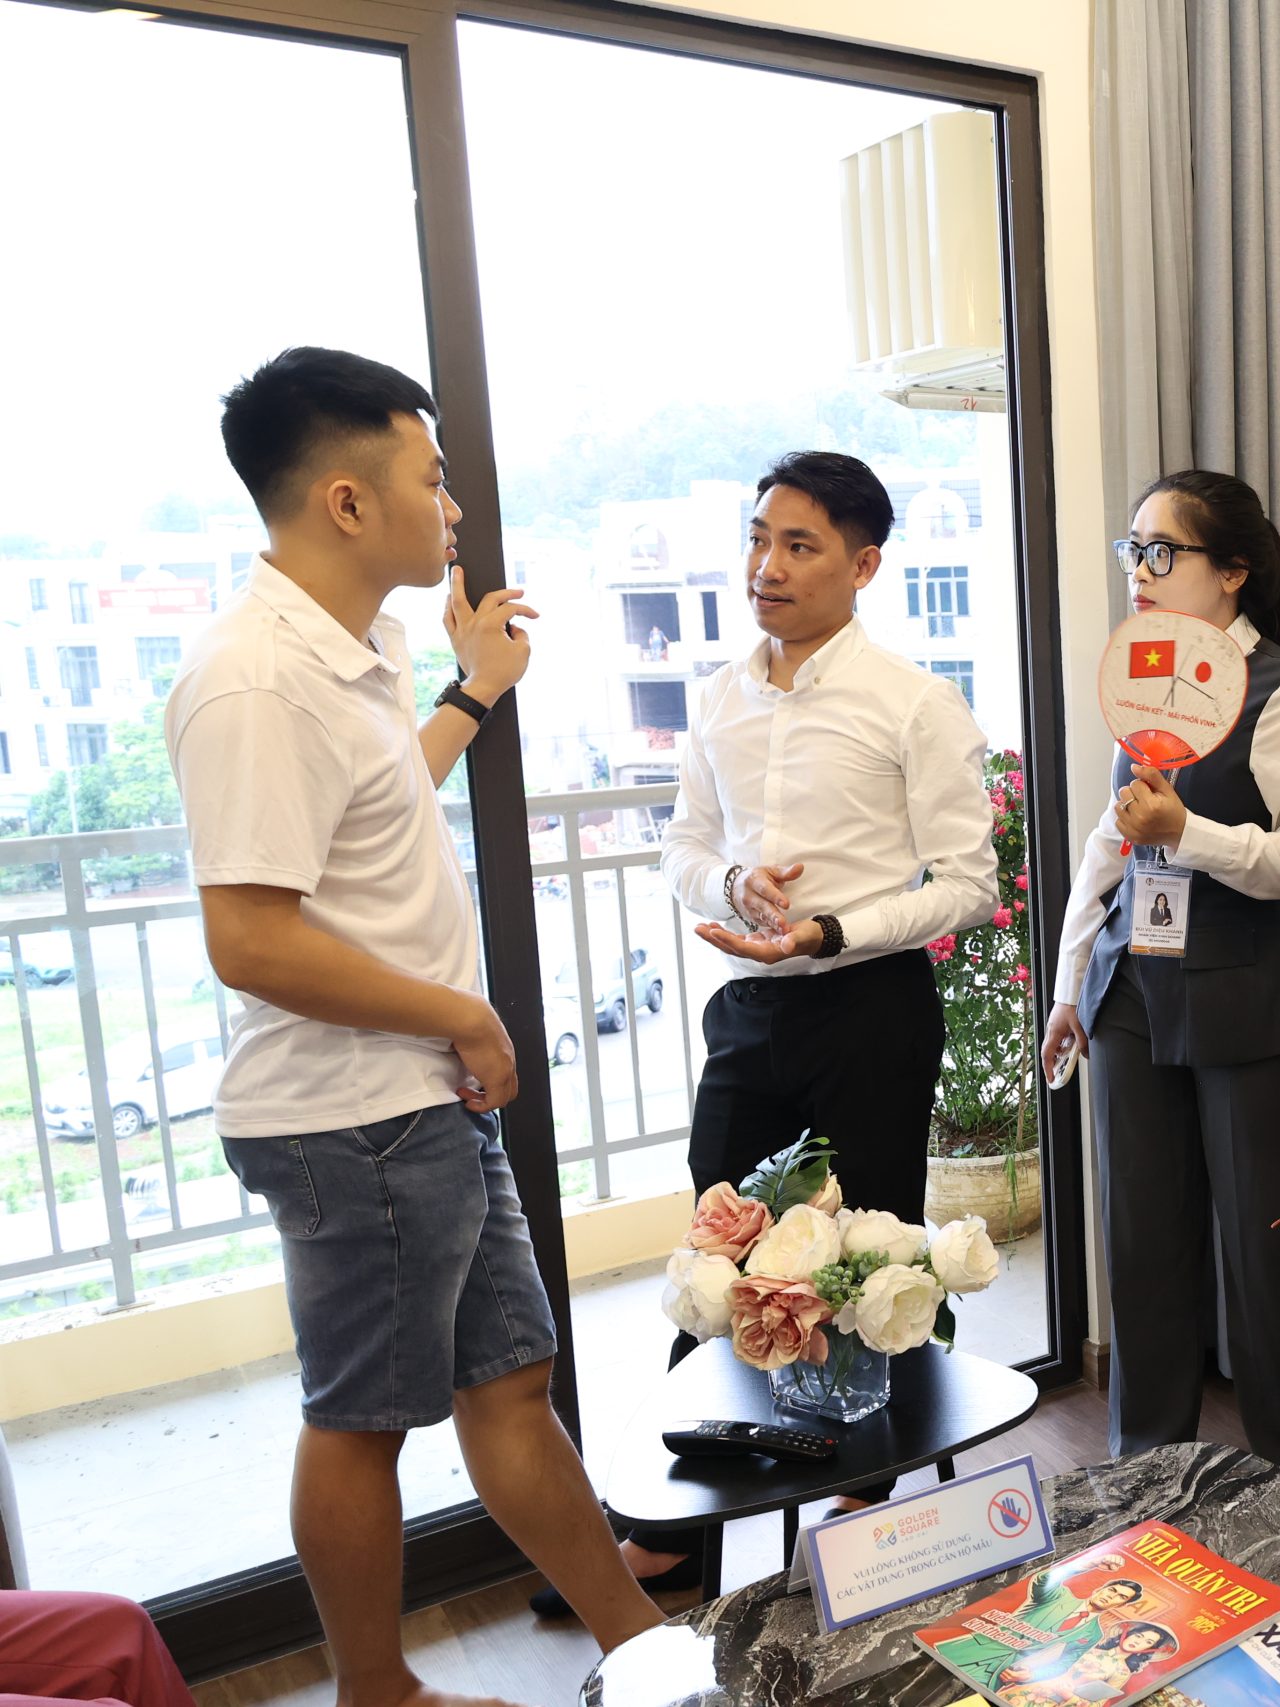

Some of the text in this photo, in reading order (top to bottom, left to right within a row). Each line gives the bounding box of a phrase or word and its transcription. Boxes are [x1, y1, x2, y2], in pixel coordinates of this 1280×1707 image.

[897, 1507, 939, 1527] GOLDEN
[899, 1516, 941, 1537] SQUARE
[906, 1558, 937, 1576] TRONG
[1124, 1532, 1183, 1567] NHÀ
[1163, 1557, 1234, 1597] QUẢN
[1215, 1584, 1269, 1617] TRỊ
